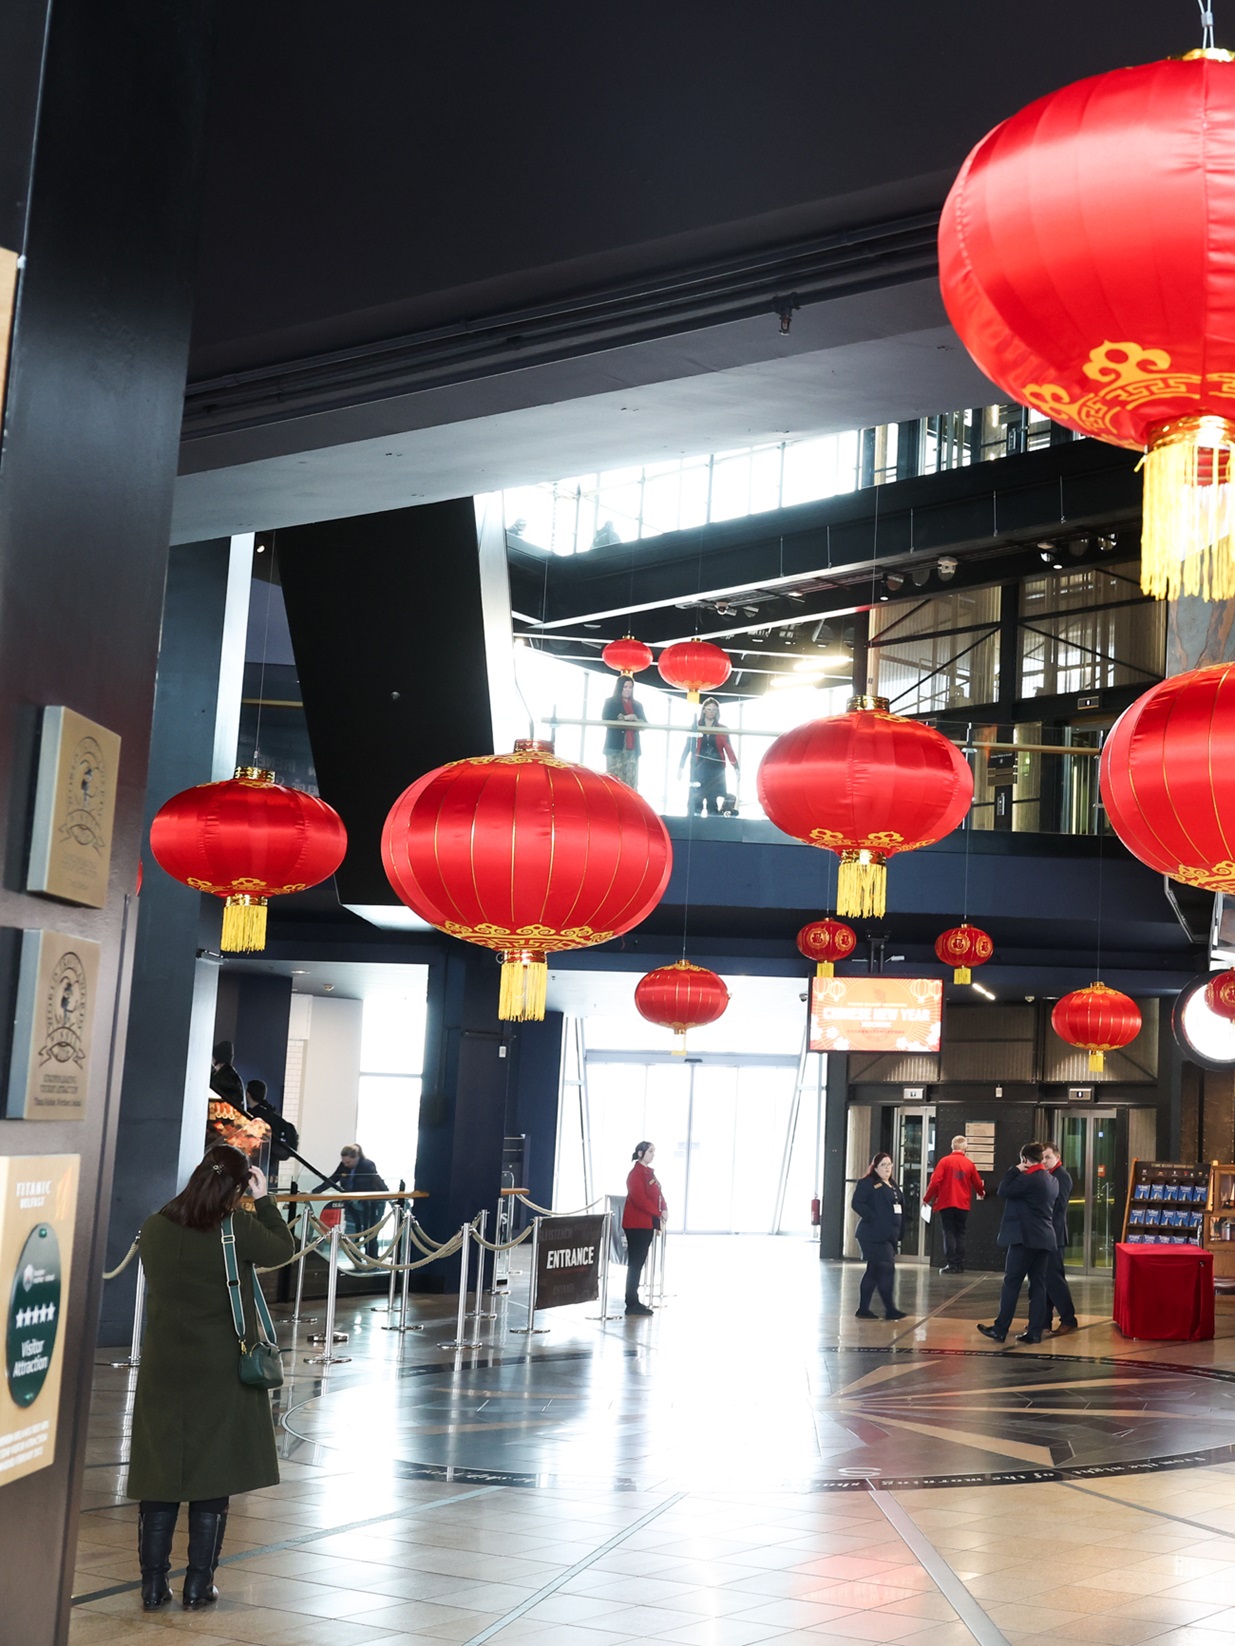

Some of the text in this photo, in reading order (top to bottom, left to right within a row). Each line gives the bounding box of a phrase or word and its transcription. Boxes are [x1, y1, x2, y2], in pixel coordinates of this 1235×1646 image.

[900, 1008, 931, 1021] YEAR
[546, 1246, 595, 1270] ENTRANCE
[20, 1338, 46, 1358] Visitor
[13, 1356, 49, 1378] Attraction
